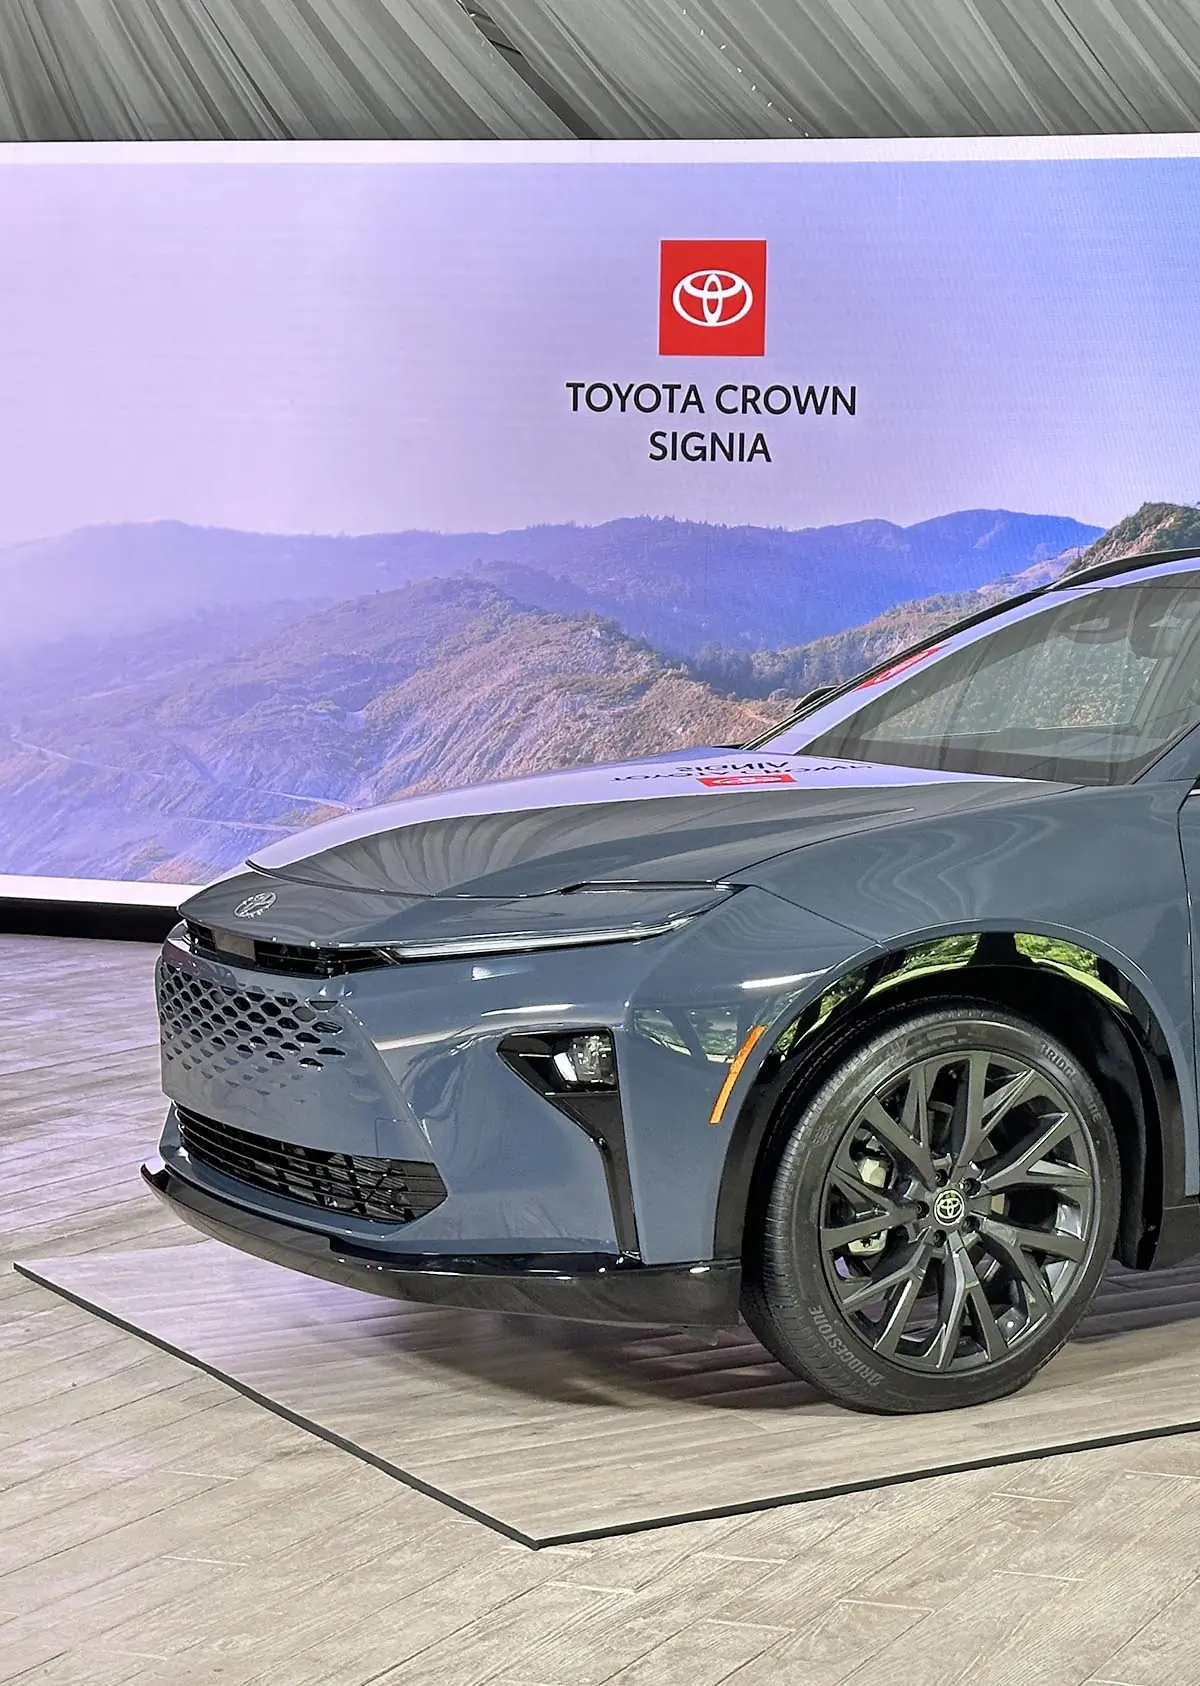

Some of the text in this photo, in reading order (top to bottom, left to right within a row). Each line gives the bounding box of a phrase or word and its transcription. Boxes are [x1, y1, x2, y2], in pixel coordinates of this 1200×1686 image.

[566, 382, 857, 415] TOYOTA CROWN
[649, 430, 772, 463] SIGNIA
[808, 1304, 885, 1386] BRIDGESTONE
